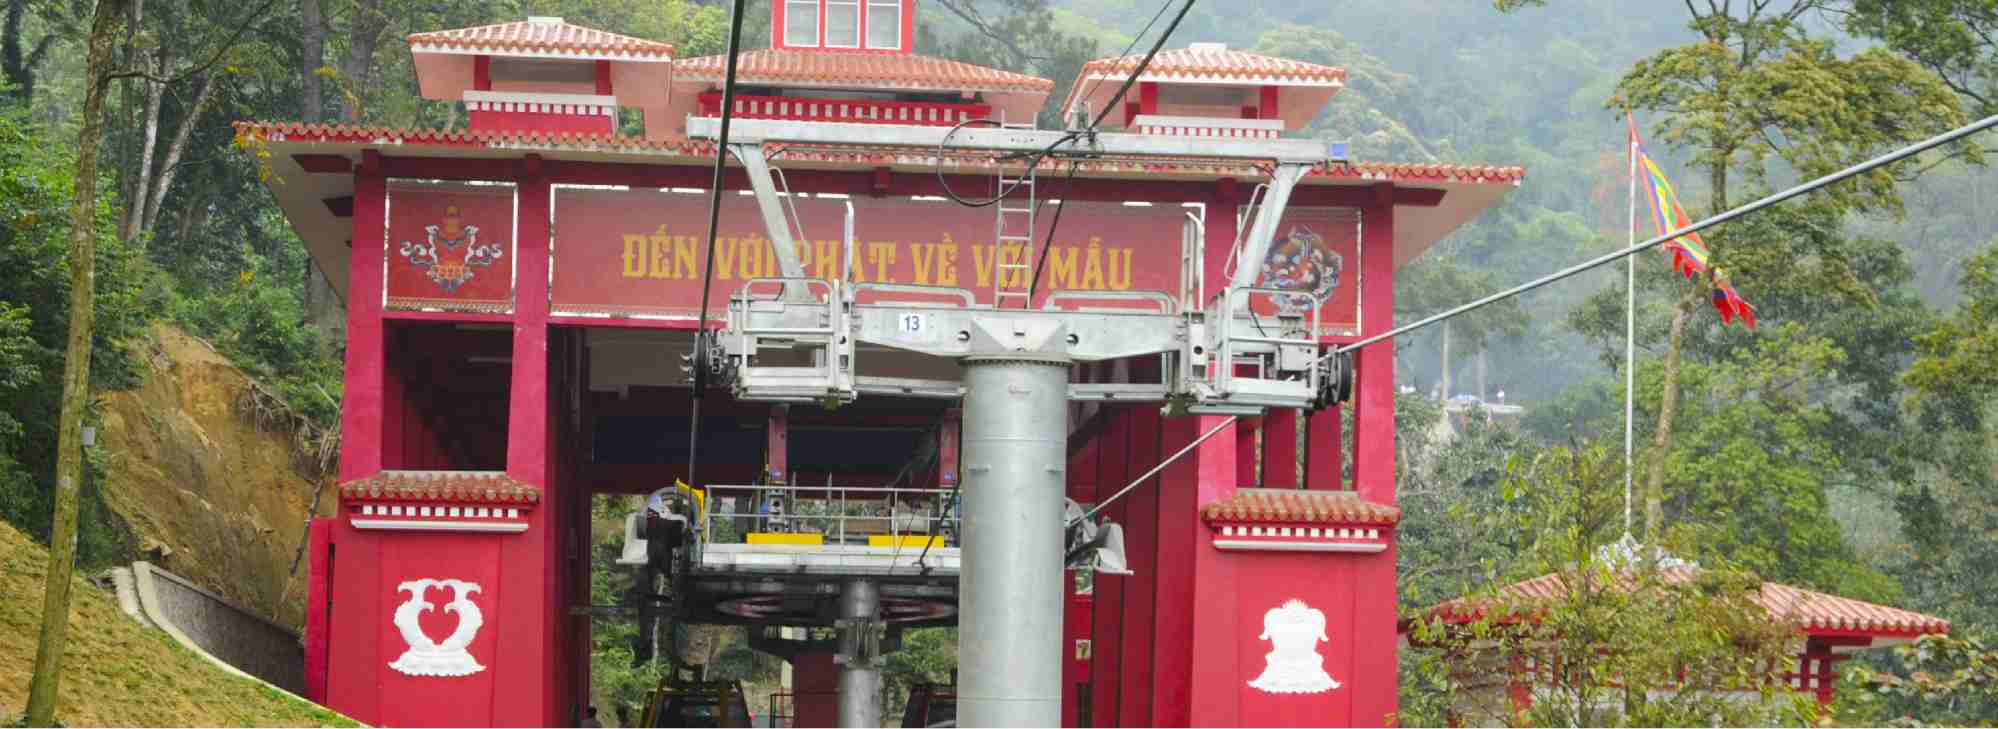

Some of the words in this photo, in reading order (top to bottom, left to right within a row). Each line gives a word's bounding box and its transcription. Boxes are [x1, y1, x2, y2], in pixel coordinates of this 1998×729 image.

[623, 224, 698, 279] ĐẾN
[911, 232, 958, 288] VỀ
[1047, 236, 1134, 290] MẪU
[904, 315, 920, 331] 13
